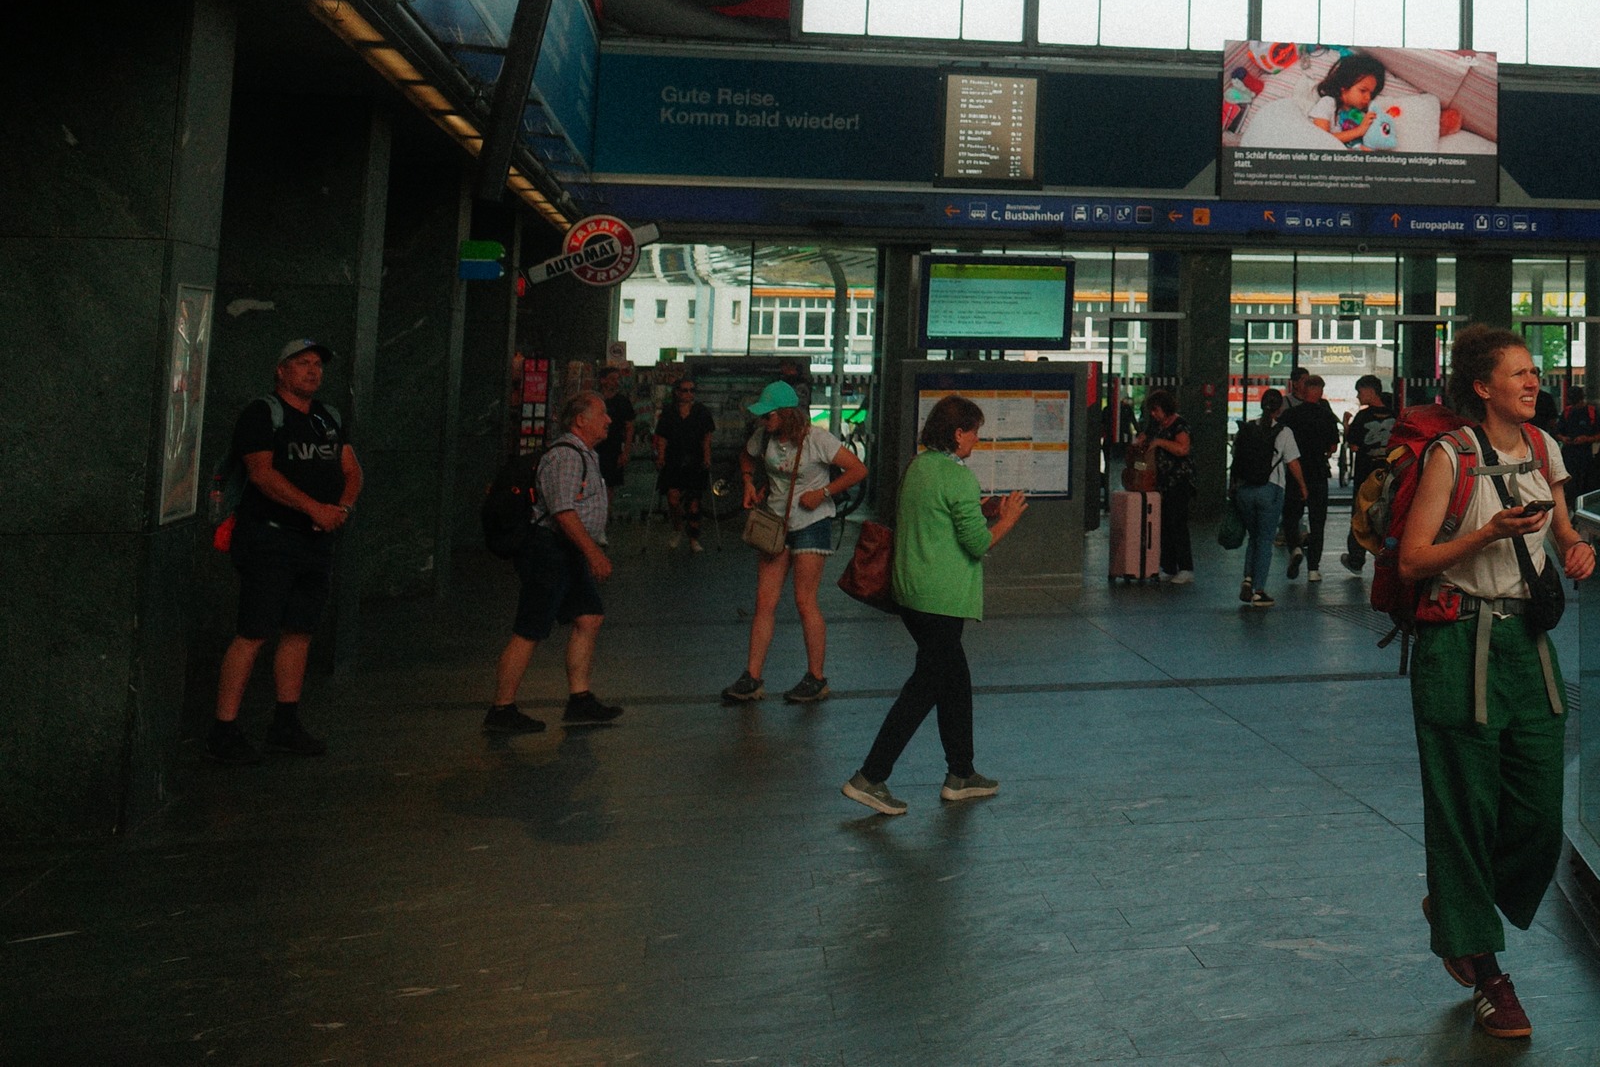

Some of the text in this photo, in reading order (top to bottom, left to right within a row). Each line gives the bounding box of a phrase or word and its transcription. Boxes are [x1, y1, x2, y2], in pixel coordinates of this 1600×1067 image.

[660, 85, 781, 108] Gute Reise.
[659, 107, 860, 132] Komm bald wieder!
[1234, 160, 1253, 168] statt.
[1245, 151, 1268, 160] Schlaf
[1268, 152, 1291, 161] finden
[1292, 153, 1308, 161] viele
[1309, 152, 1320, 161] für
[1321, 153, 1333, 162] die
[1333, 153, 1364, 163] kindliche
[1365, 155, 1407, 166] Entwicklung
[1408, 157, 1437, 166] wichtige
[1438, 157, 1467, 166] Prozesse
[991, 210, 1065, 222] C, Busbahnhof
[1410, 219, 1465, 231] Europaplatz
[569, 220, 623, 247] TABAK
[545, 239, 617, 277] AUTOMAT
[585, 245, 634, 282] TRAFIK
